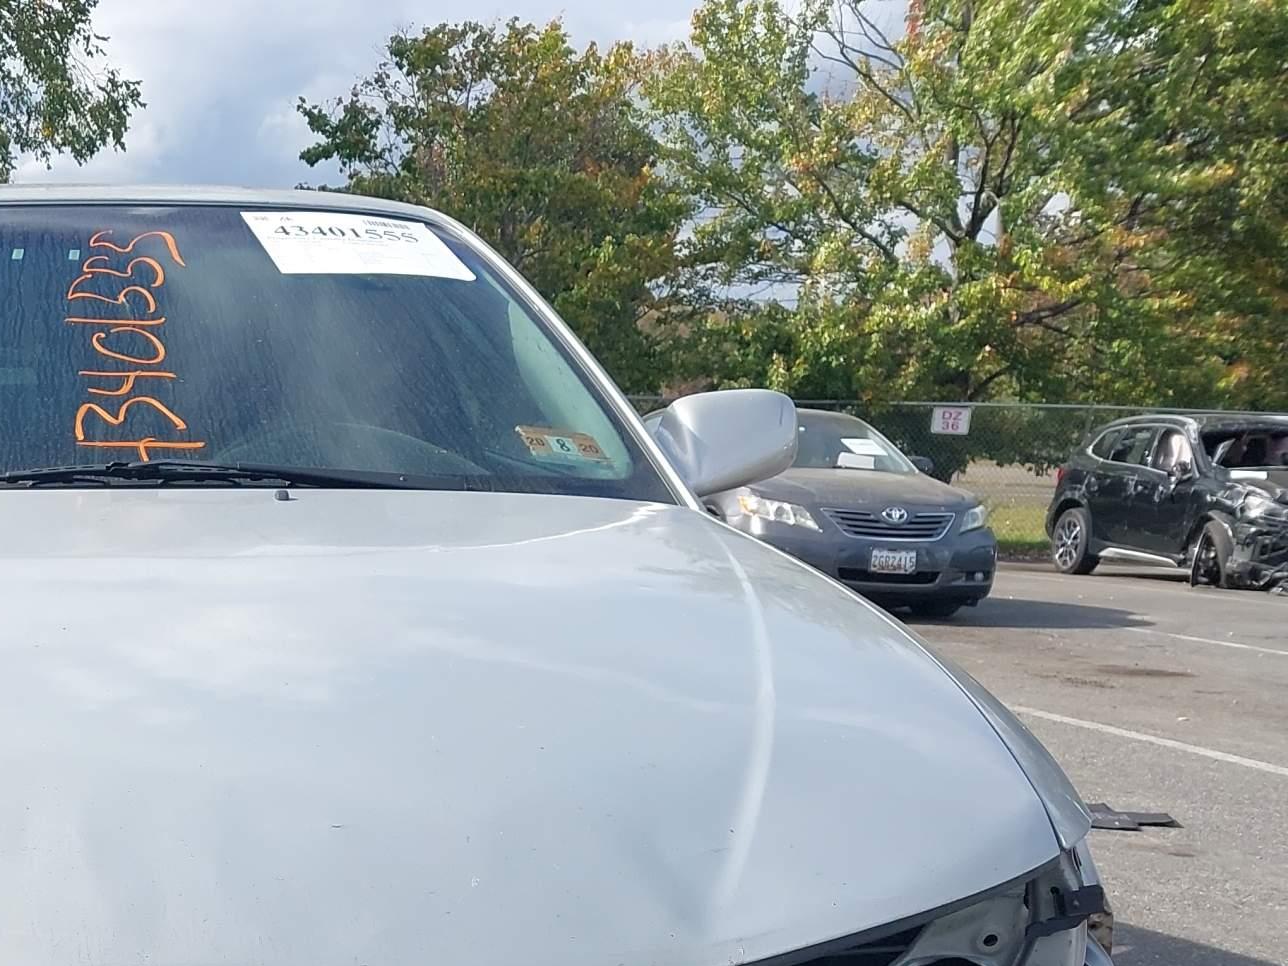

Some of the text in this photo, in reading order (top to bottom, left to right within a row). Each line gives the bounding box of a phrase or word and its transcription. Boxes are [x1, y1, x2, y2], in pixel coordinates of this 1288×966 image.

[273, 224, 419, 244] 43401555
[941, 410, 963, 421] DZ
[941, 421, 960, 431] 36
[555, 438, 571, 452] 8
